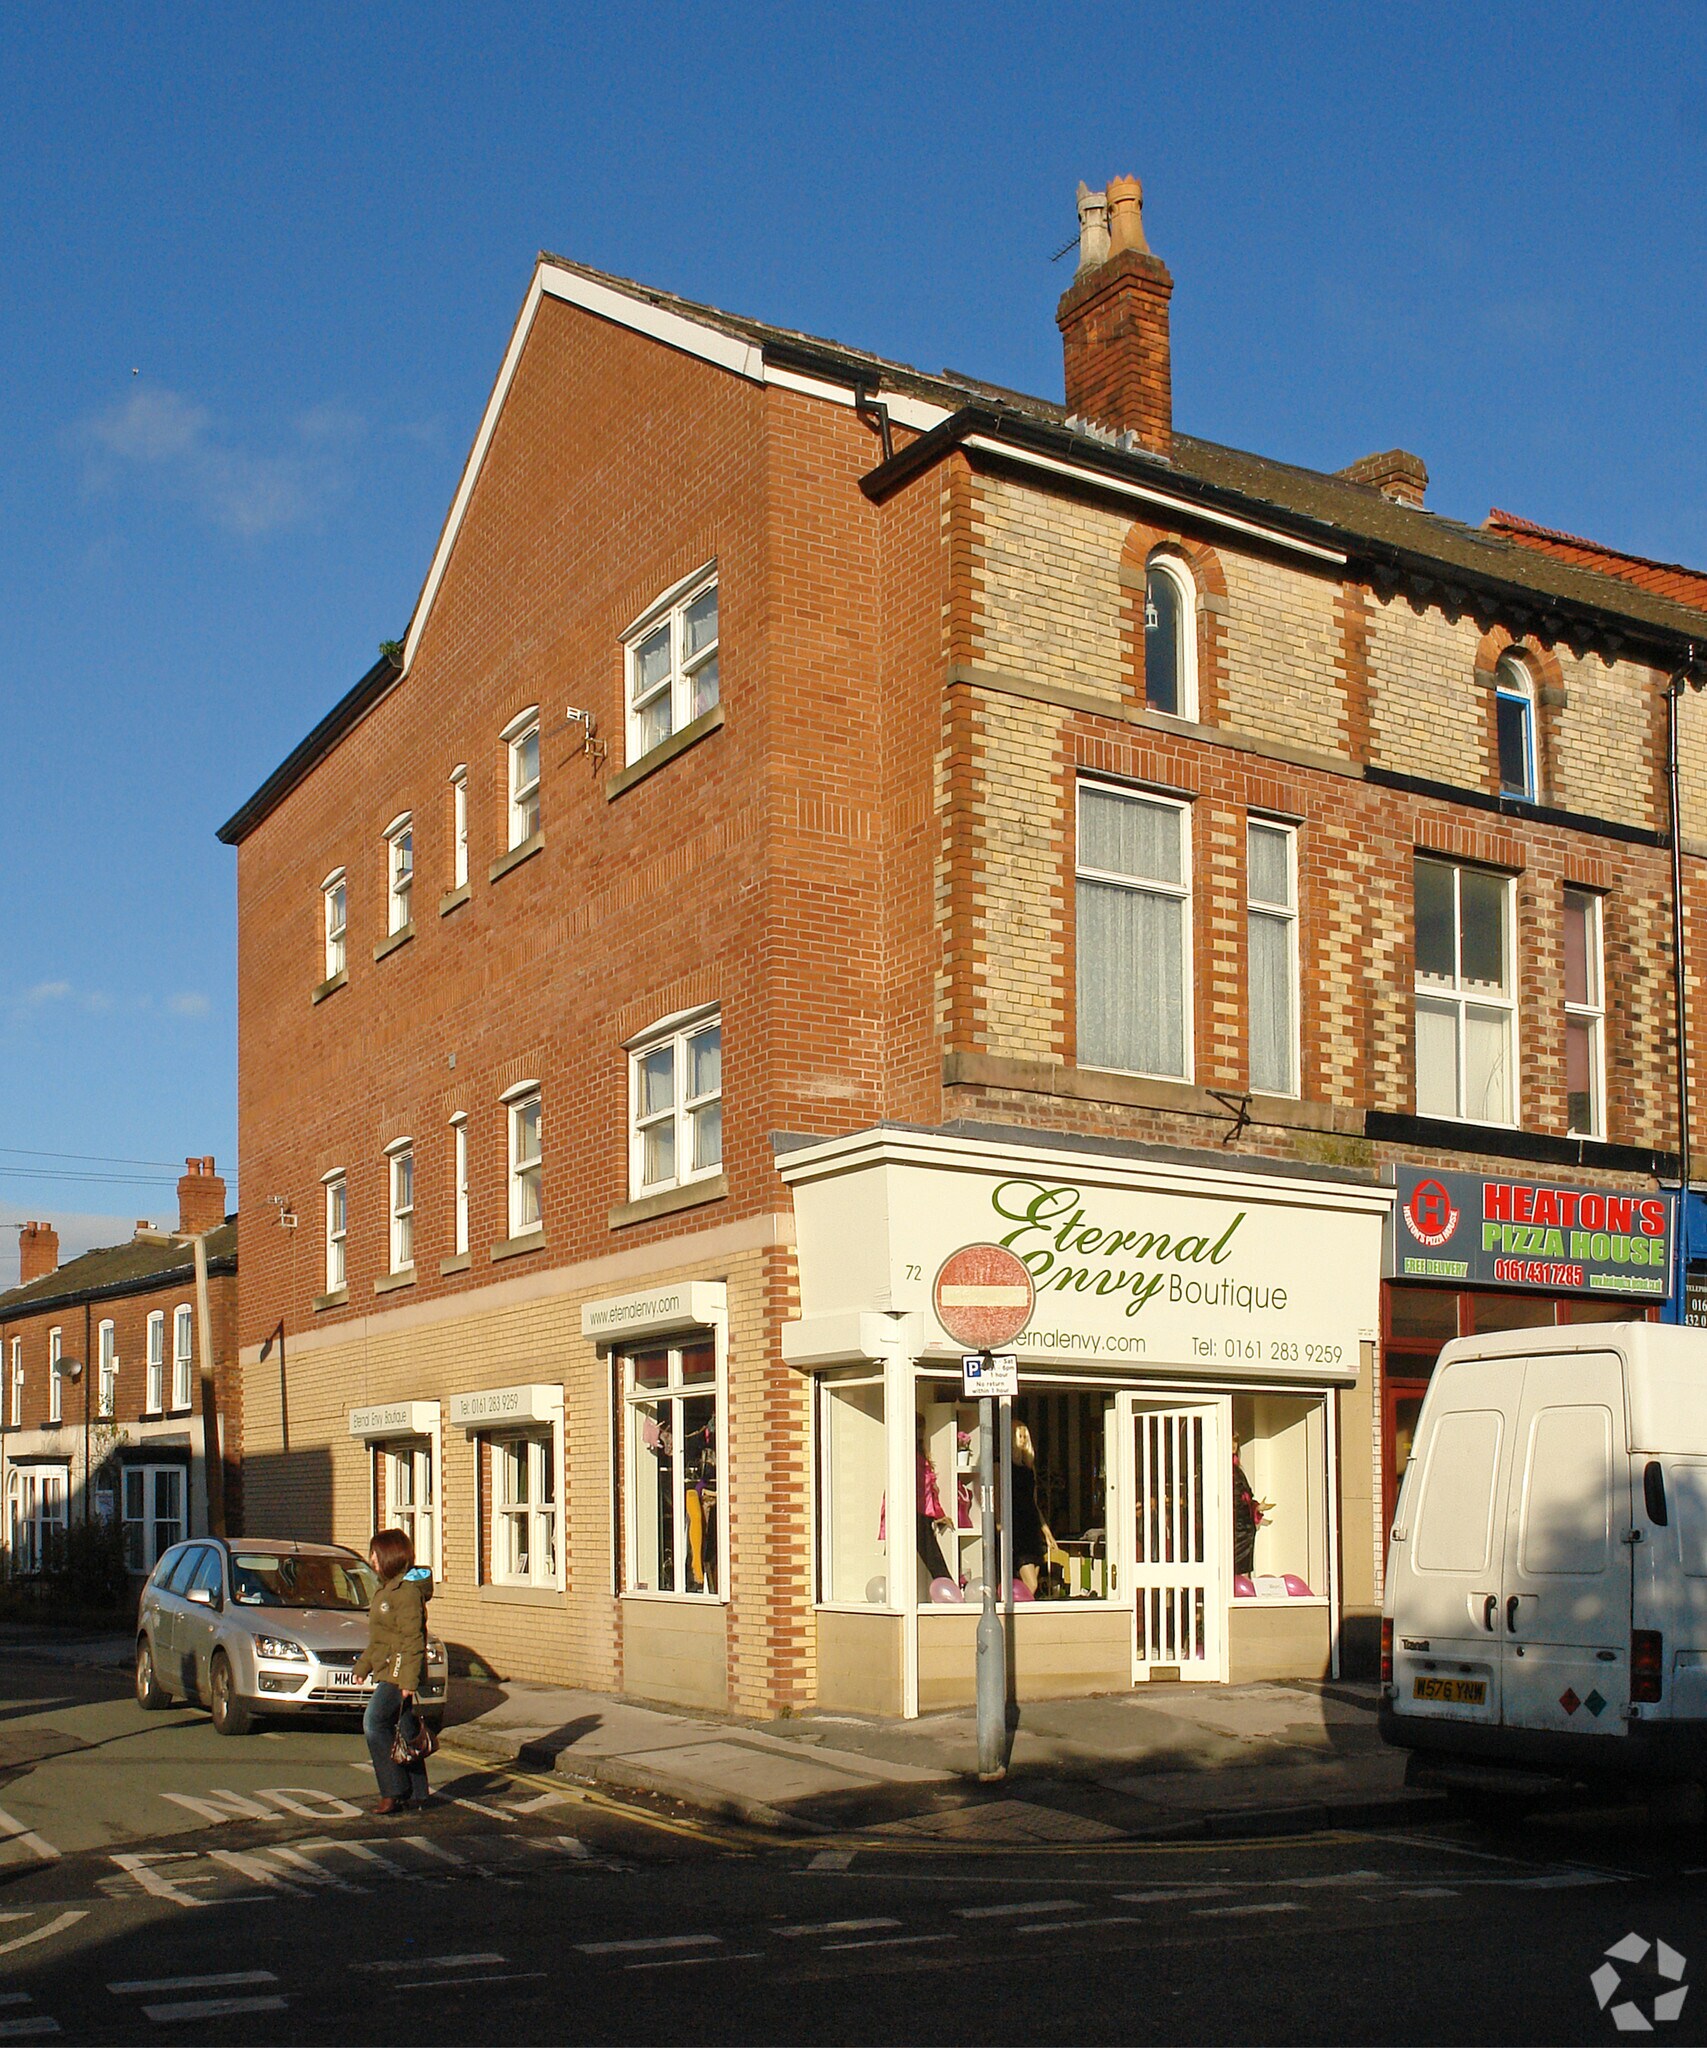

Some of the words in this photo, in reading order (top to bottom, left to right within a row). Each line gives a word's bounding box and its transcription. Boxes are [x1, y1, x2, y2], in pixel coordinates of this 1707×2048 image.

[992, 1180, 1247, 1264] Eternal
[1482, 1182, 1666, 1237] HEATON'S
[1425, 1233, 1445, 1246] PIZZA
[1442, 1209, 1459, 1240] HOUSE
[1481, 1222, 1566, 1258] PIZZA
[1570, 1230, 1666, 1267] HOUSE
[905, 1264, 922, 1281] 72
[1404, 1257, 1426, 1275] FREE
[1426, 1259, 1469, 1278] DELIVERY
[1494, 1258, 1526, 1282] 0161
[1526, 1260, 1551, 1284] 431
[1550, 1262, 1584, 1287] 7285
[1169, 1273, 1288, 1313] Boutique
[589, 1295, 680, 1326] www.eternalenvy.com
[1191, 1337, 1217, 1357] Tel:
[1224, 1338, 1262, 1359] 0161
[1270, 1341, 1299, 1362] 283
[1304, 1343, 1343, 1364] 9259
[353, 1413, 369, 1429] Eternal
[371, 1412, 383, 1429] Envy
[384, 1409, 407, 1425] Boutique
[471, 1398, 487, 1415] 0161
[489, 1396, 501, 1413] 283
[502, 1393, 519, 1411] 9259
[1416, 1679, 1452, 1699] W576
[158, 1787, 365, 1823] NO
